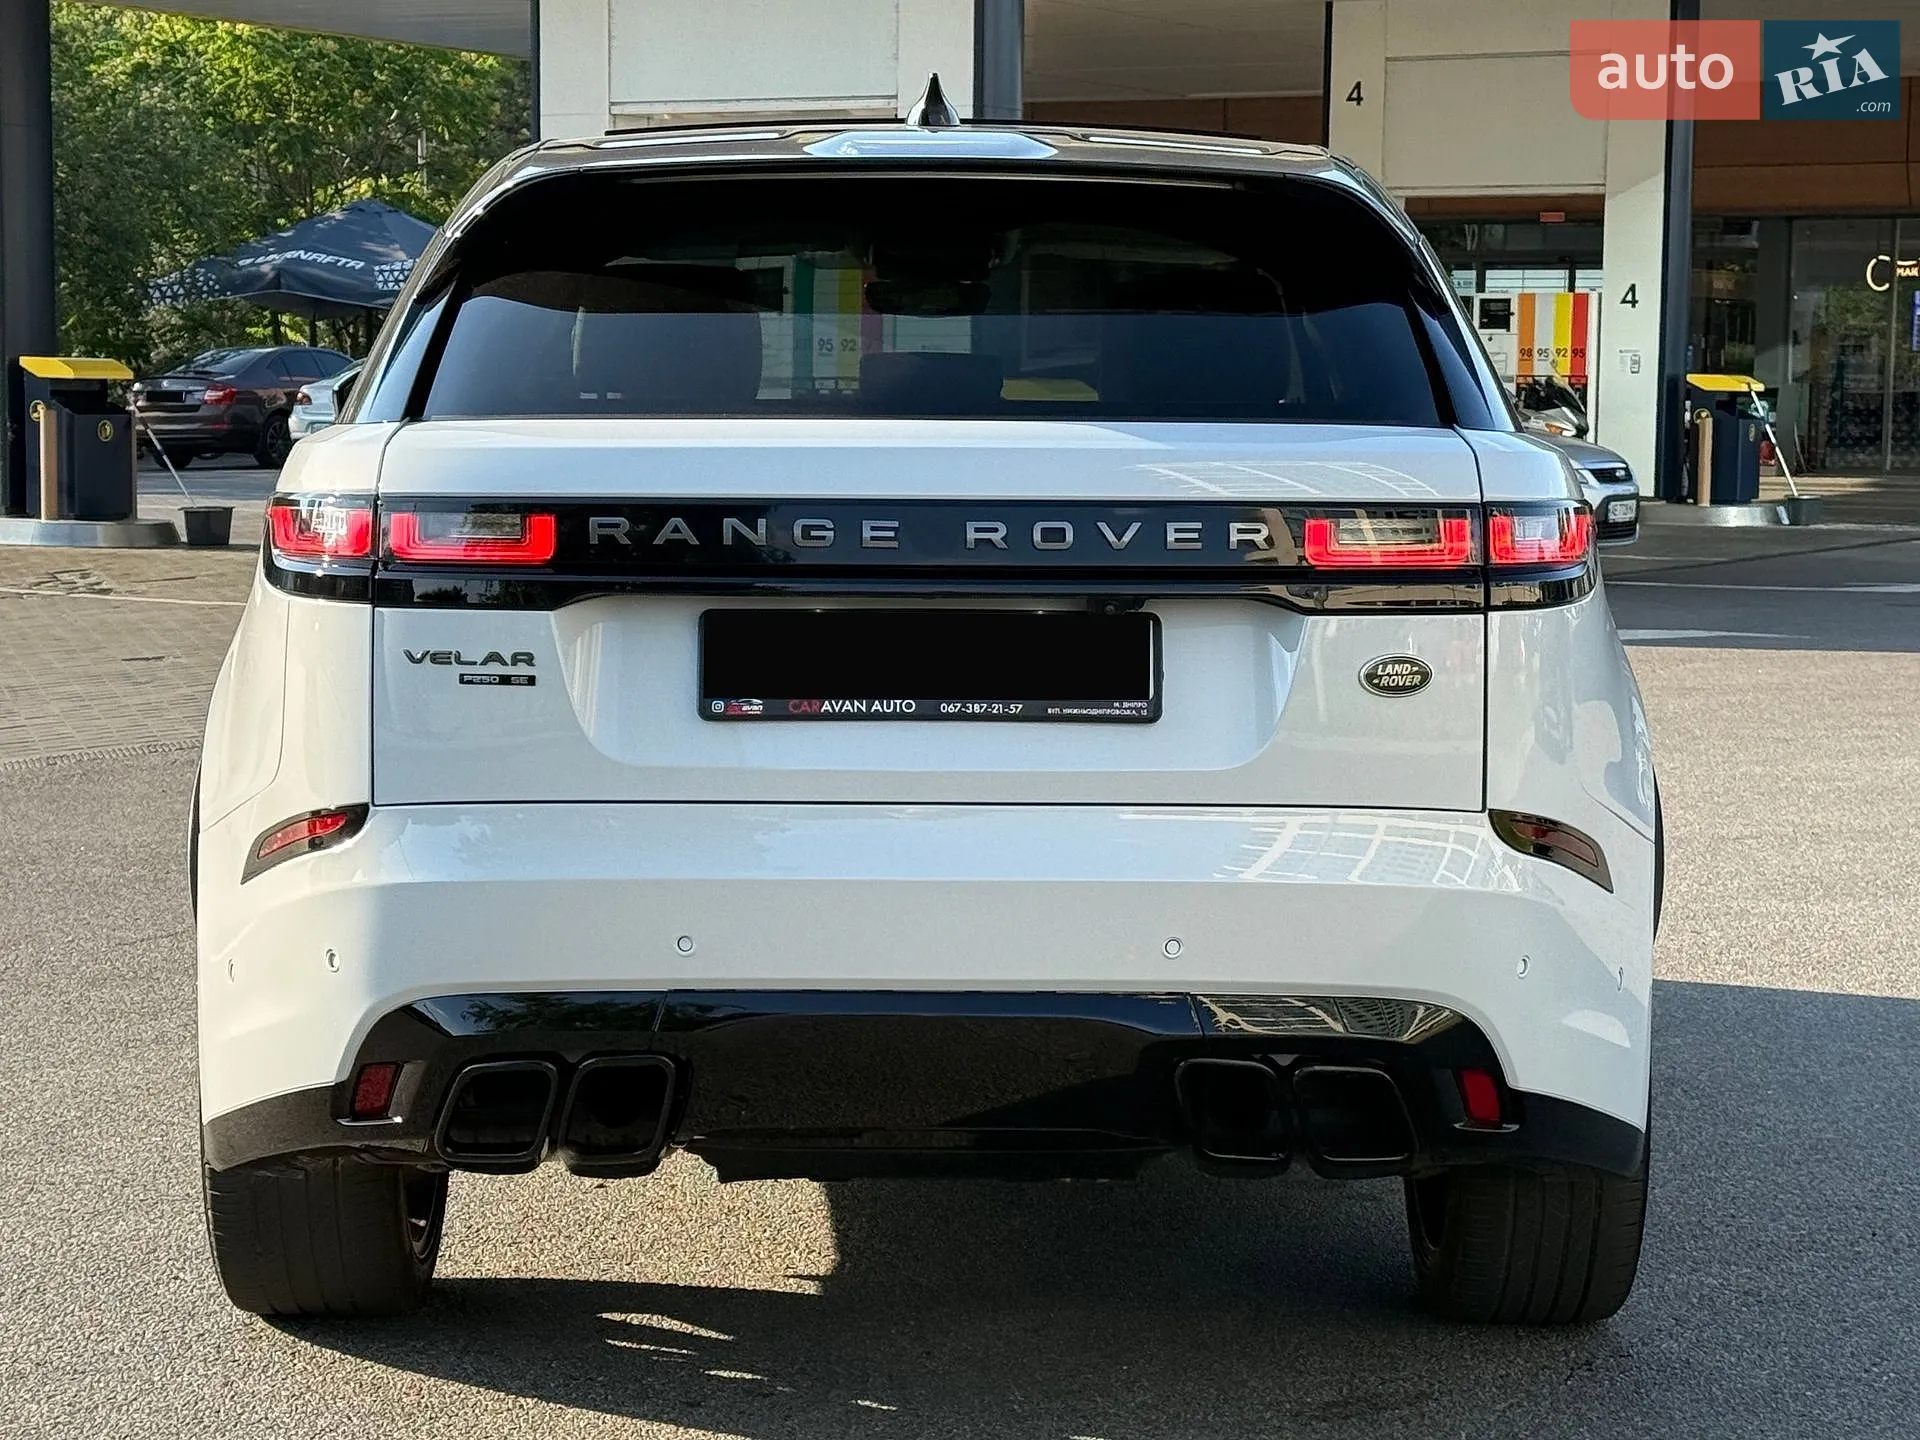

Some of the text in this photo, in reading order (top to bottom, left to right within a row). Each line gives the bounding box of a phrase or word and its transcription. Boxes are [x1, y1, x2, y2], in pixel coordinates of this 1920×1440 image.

[1345, 80, 1364, 106] 4
[1619, 283, 1639, 308] 4
[817, 337, 857, 352] 95 92
[1519, 347, 1586, 358] 98 95 92 95
[588, 516, 1271, 550] RANGE ROVER
[403, 649, 536, 667] VELAR
[1377, 663, 1411, 676] LAND
[463, 674, 529, 685] P250 SE
[1380, 674, 1422, 687] ROVER
[788, 699, 916, 713] CARAVAN AUTO
[940, 702, 1023, 714] 067-387-21-57
